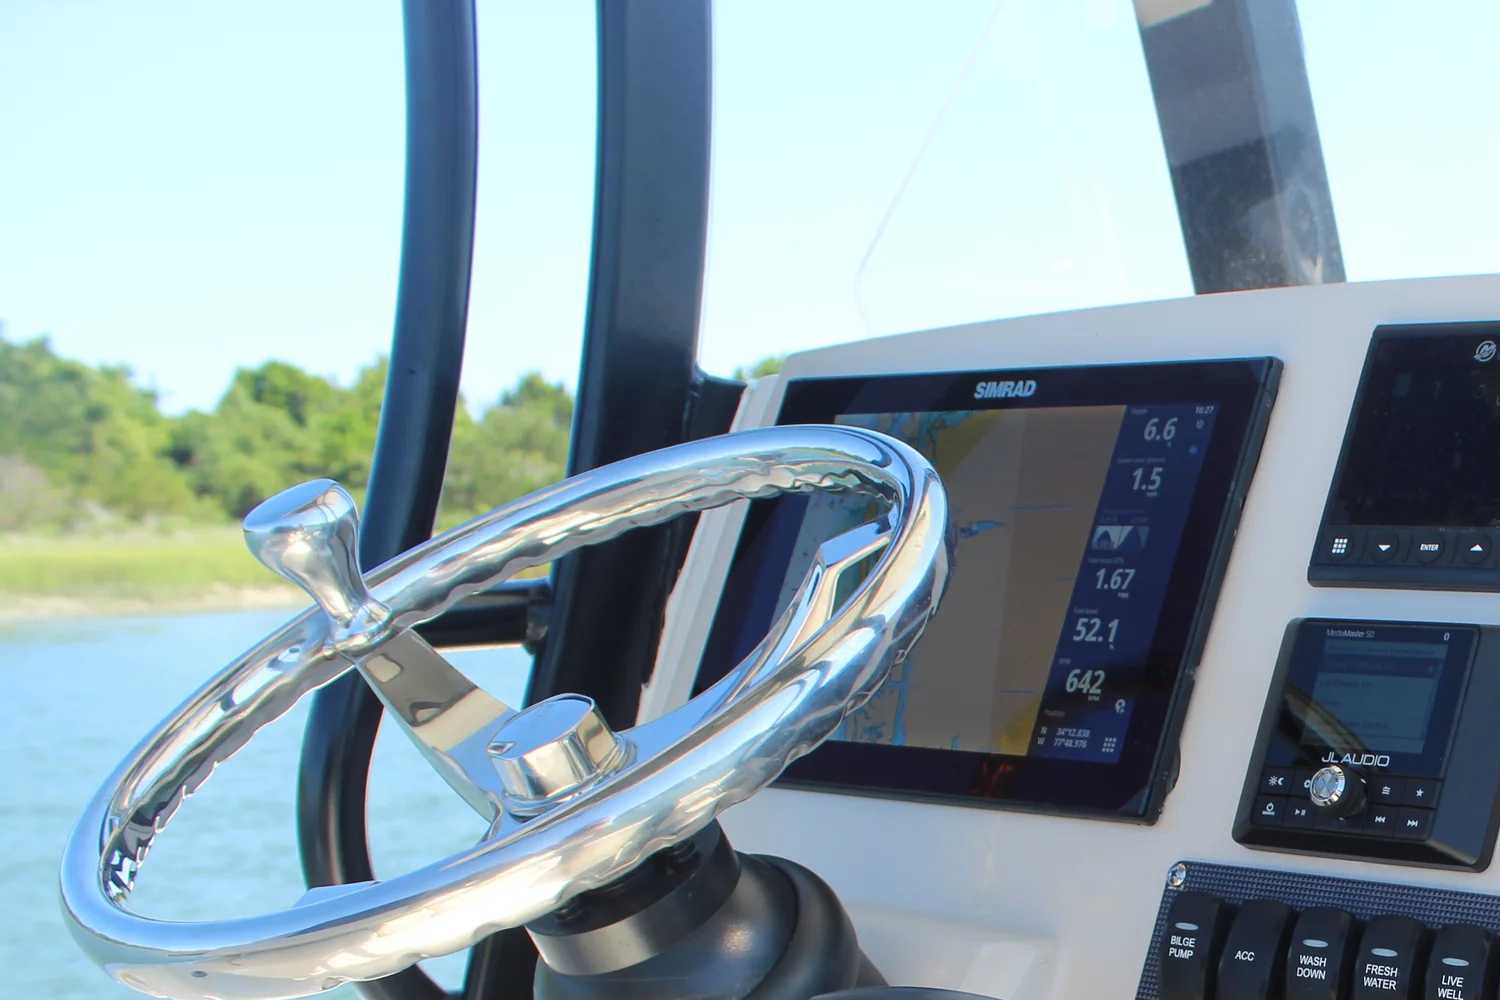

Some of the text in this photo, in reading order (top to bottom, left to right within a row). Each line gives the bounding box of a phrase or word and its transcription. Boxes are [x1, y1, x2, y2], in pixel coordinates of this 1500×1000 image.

[973, 380, 1037, 399] SIMRAD
[1143, 417, 1178, 441] 6.6
[1132, 467, 1163, 490] 1.5
[1096, 568, 1136, 590] 1.67
[1072, 617, 1119, 643] 52.1
[1065, 668, 1105, 694] 642
[1321, 751, 1390, 767] JL AUDIO
[1170, 936, 1196, 948] BILGE
[1168, 947, 1193, 960] PUMP
[1234, 950, 1255, 962] ACC
[1299, 954, 1327, 968] WASH
[1296, 967, 1326, 980] DOWN
[1365, 963, 1398, 978] FRESH
[1363, 976, 1397, 991] WATER
[1441, 975, 1464, 988] LIVE
[1437, 987, 1464, 1000] WELL
